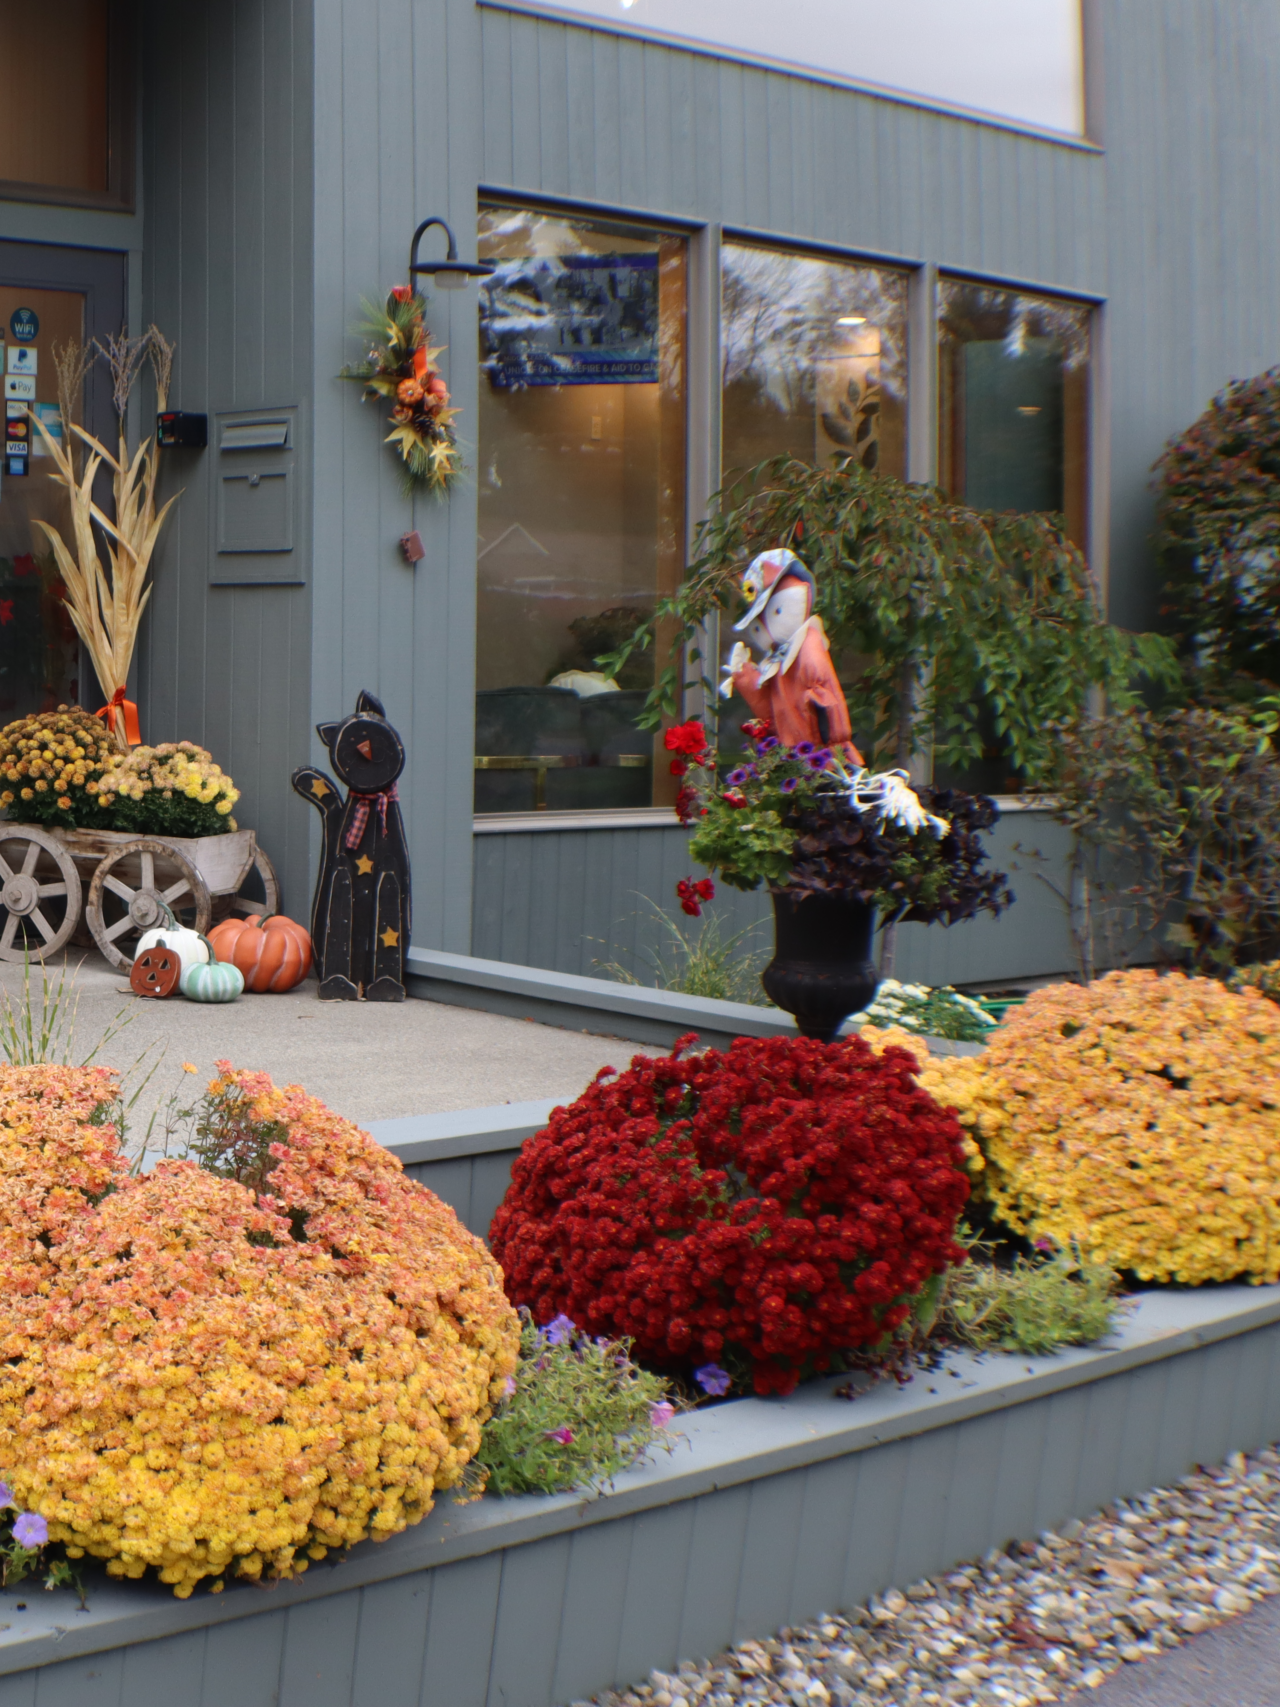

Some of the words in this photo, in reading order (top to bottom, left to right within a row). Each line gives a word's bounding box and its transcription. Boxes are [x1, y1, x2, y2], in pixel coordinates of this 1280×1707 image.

[14, 322, 34, 333] WiFi
[504, 365, 536, 374] UNICF
[538, 364, 552, 373] ON
[554, 363, 601, 373] CEASEFIRE
[603, 363, 609, 372] &
[612, 363, 627, 372] AID
[628, 363, 641, 372] TO
[18, 381, 32, 393] Pay
[9, 443, 26, 451] VISA
